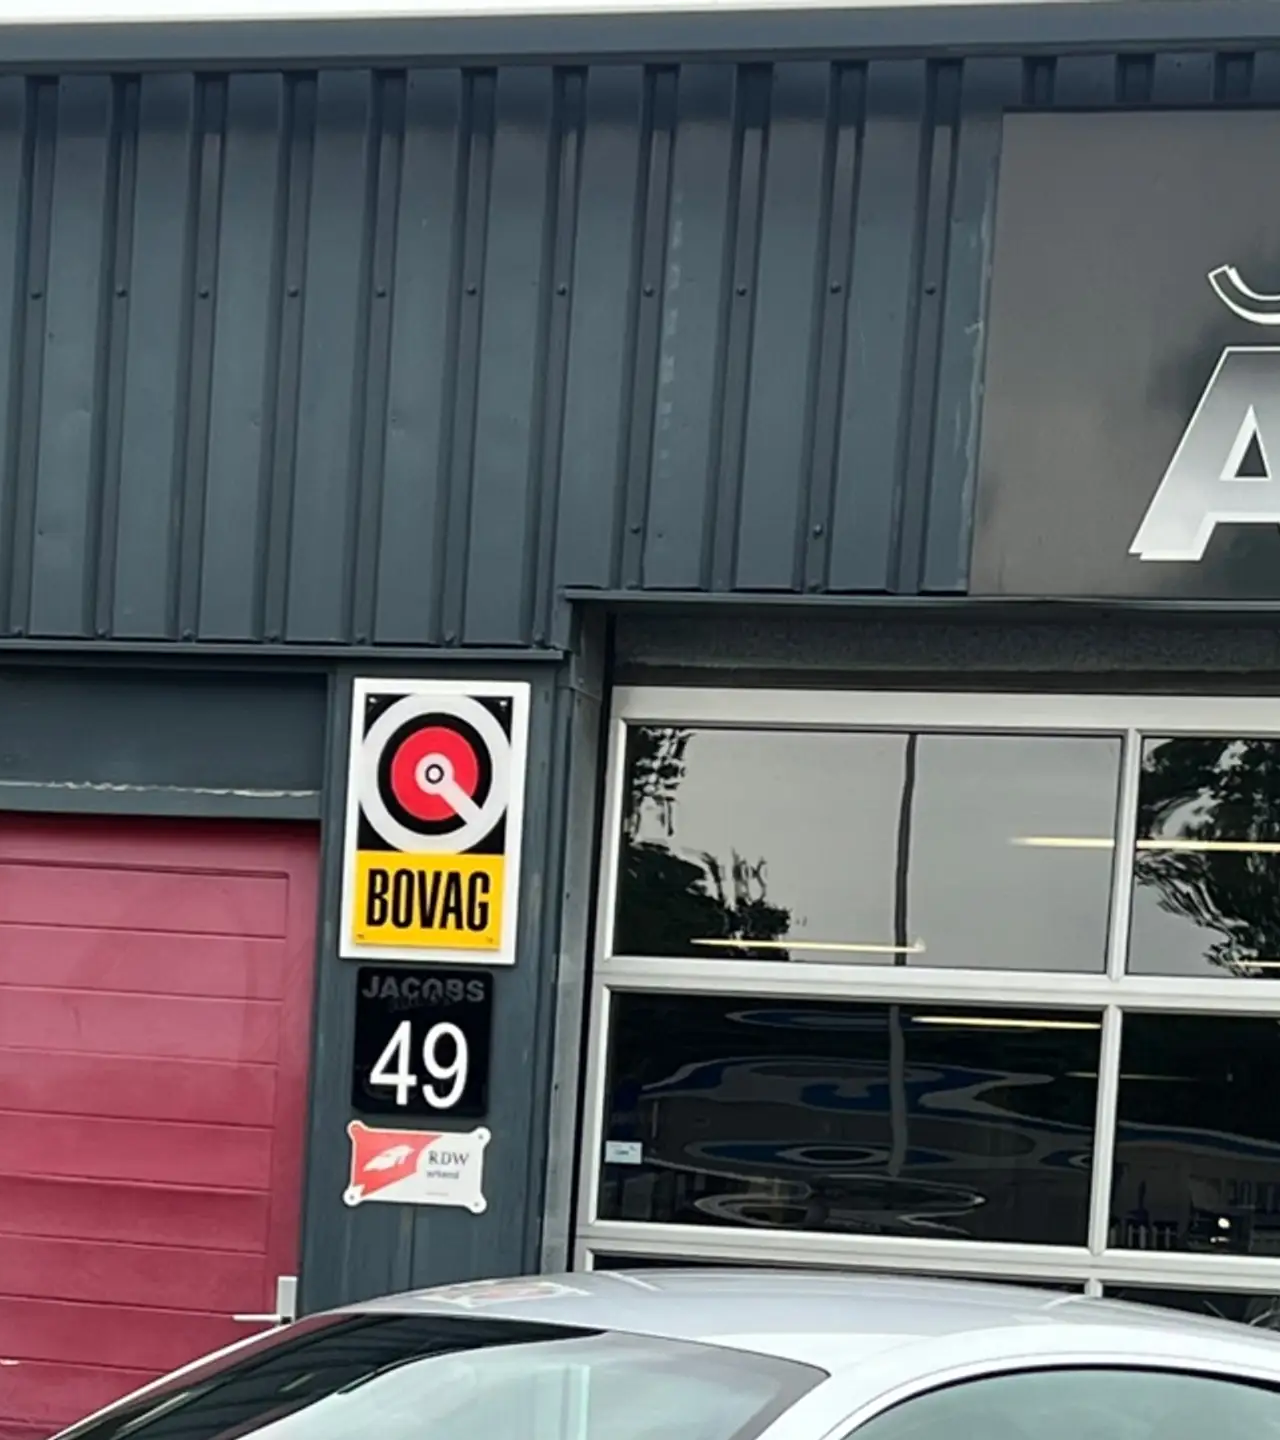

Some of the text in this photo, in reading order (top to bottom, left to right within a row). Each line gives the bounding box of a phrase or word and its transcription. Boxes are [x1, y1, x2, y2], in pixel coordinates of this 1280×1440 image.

[366, 868, 492, 932] BOVAG
[361, 975, 486, 1003] JACOBS
[369, 1020, 469, 1109] 49
[428, 1150, 470, 1166] RDW
